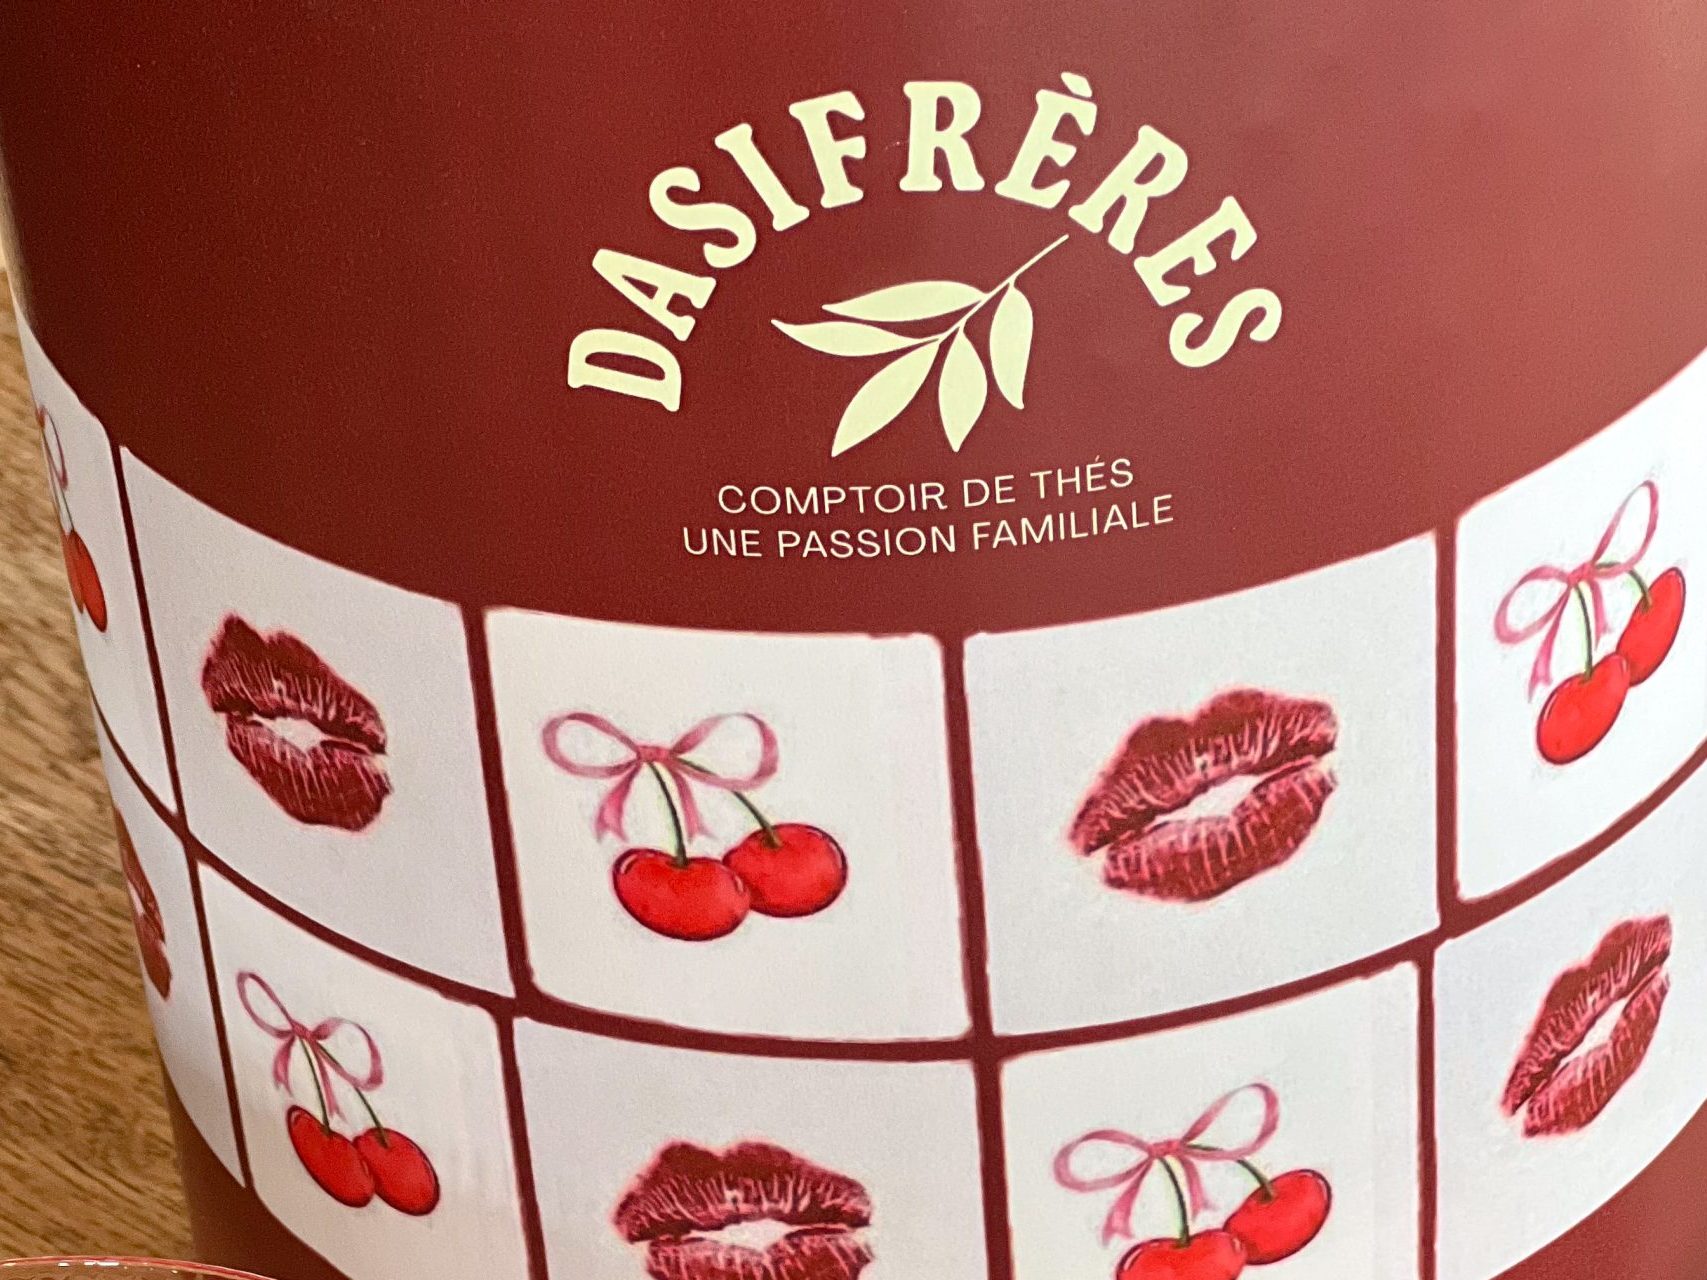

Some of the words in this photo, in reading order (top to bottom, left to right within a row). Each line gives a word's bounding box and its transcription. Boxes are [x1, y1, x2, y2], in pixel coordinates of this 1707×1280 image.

[718, 482, 948, 515] COMPTOIR
[962, 474, 1016, 508] DE
[1029, 455, 1134, 499] THÉS
[683, 526, 762, 557] UNE
[777, 524, 956, 559] PASSION
[972, 493, 1174, 551] FAMILIALE
